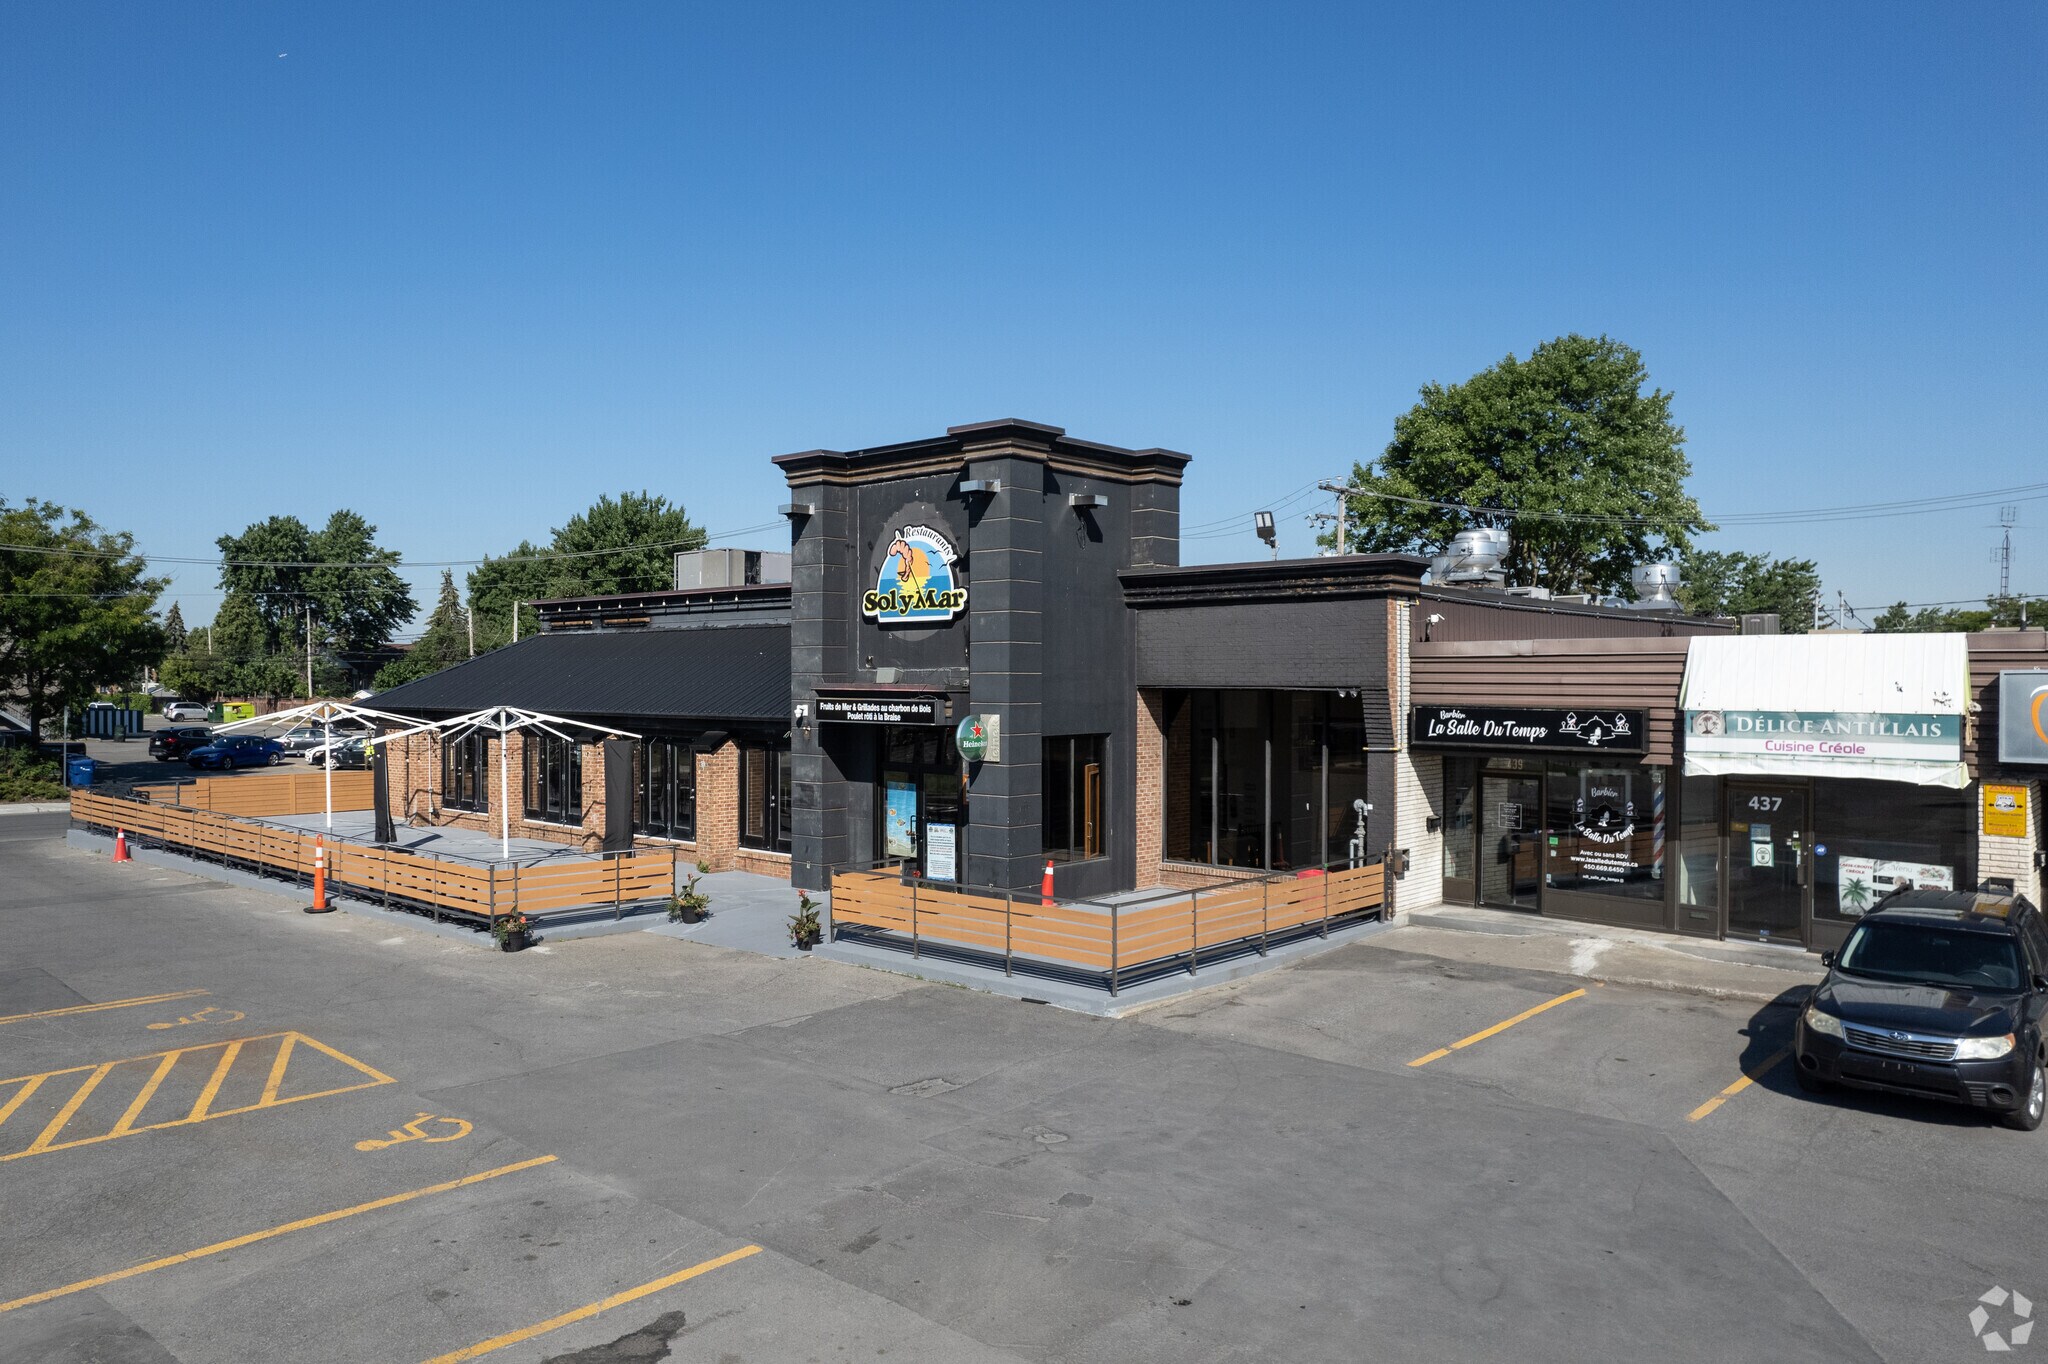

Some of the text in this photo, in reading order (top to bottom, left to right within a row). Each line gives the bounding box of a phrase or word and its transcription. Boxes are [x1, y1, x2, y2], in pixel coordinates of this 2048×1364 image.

[864, 589, 964, 614] Sol y Mar
[820, 702, 834, 711] Fruits
[835, 703, 841, 711] de
[842, 703, 852, 711] Mer
[852, 703, 857, 711] &
[857, 703, 880, 712] Grillades
[888, 704, 910, 712] charbon
[919, 704, 932, 713] Bois
[1440, 709, 1466, 720] Barbier
[847, 712, 863, 720] Poulet
[873, 712, 877, 720] à
[878, 713, 883, 721] la
[884, 713, 901, 722] Braise
[1428, 718, 1548, 743] La Salle Du Temps
[1736, 715, 1942, 738] DÉLICE ANTILLAIS
[1765, 740, 1866, 755] Cuisine Créole
[1591, 786, 1619, 798] Barbier
[1748, 795, 1782, 811] 437
[1583, 827, 1602, 843] Salle
[1603, 834, 1615, 844] Du
[1613, 823, 1635, 842] Temps
